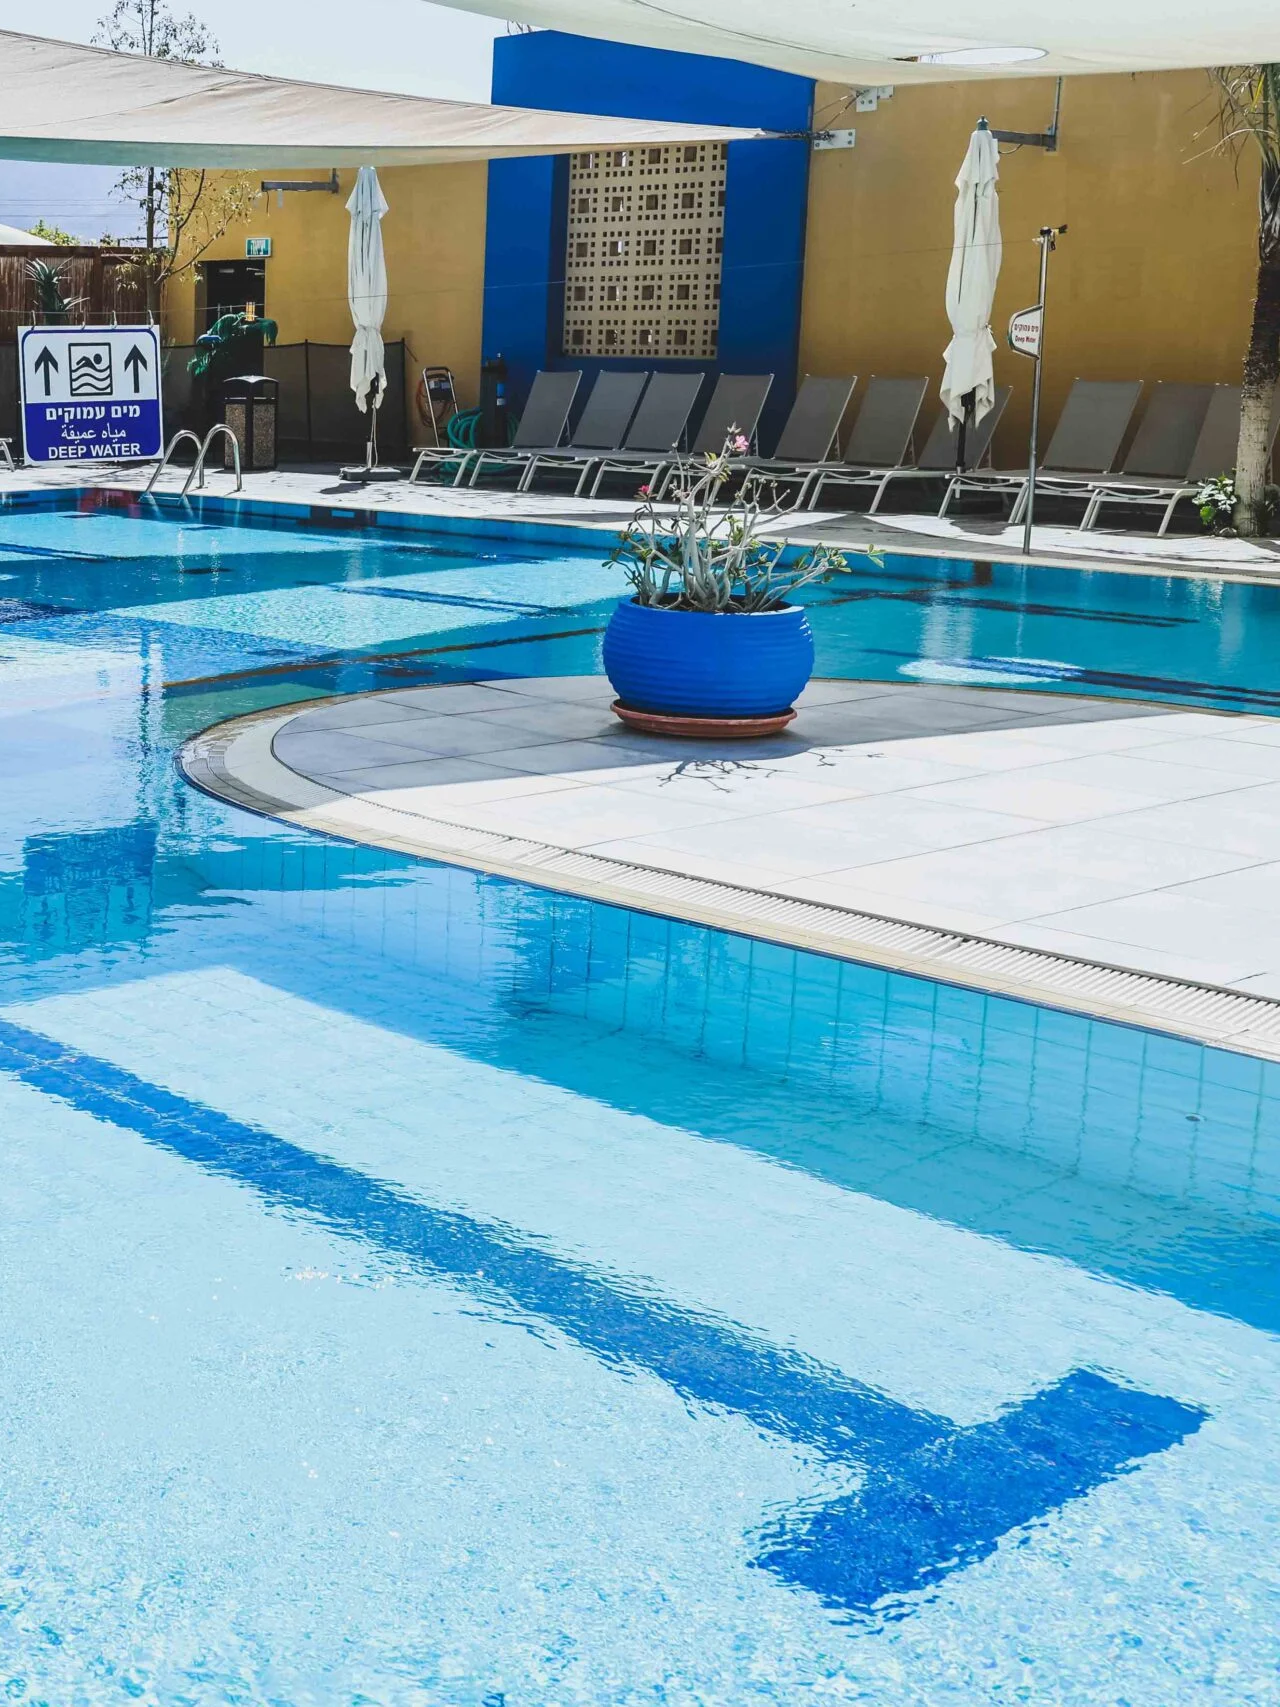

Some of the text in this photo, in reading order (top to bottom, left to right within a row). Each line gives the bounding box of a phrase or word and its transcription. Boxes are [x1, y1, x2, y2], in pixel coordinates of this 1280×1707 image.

[45, 404, 141, 423] מים עמוקים
[61, 423, 126, 444] مياه عميقة
[48, 443, 141, 459] DEEP WATER
